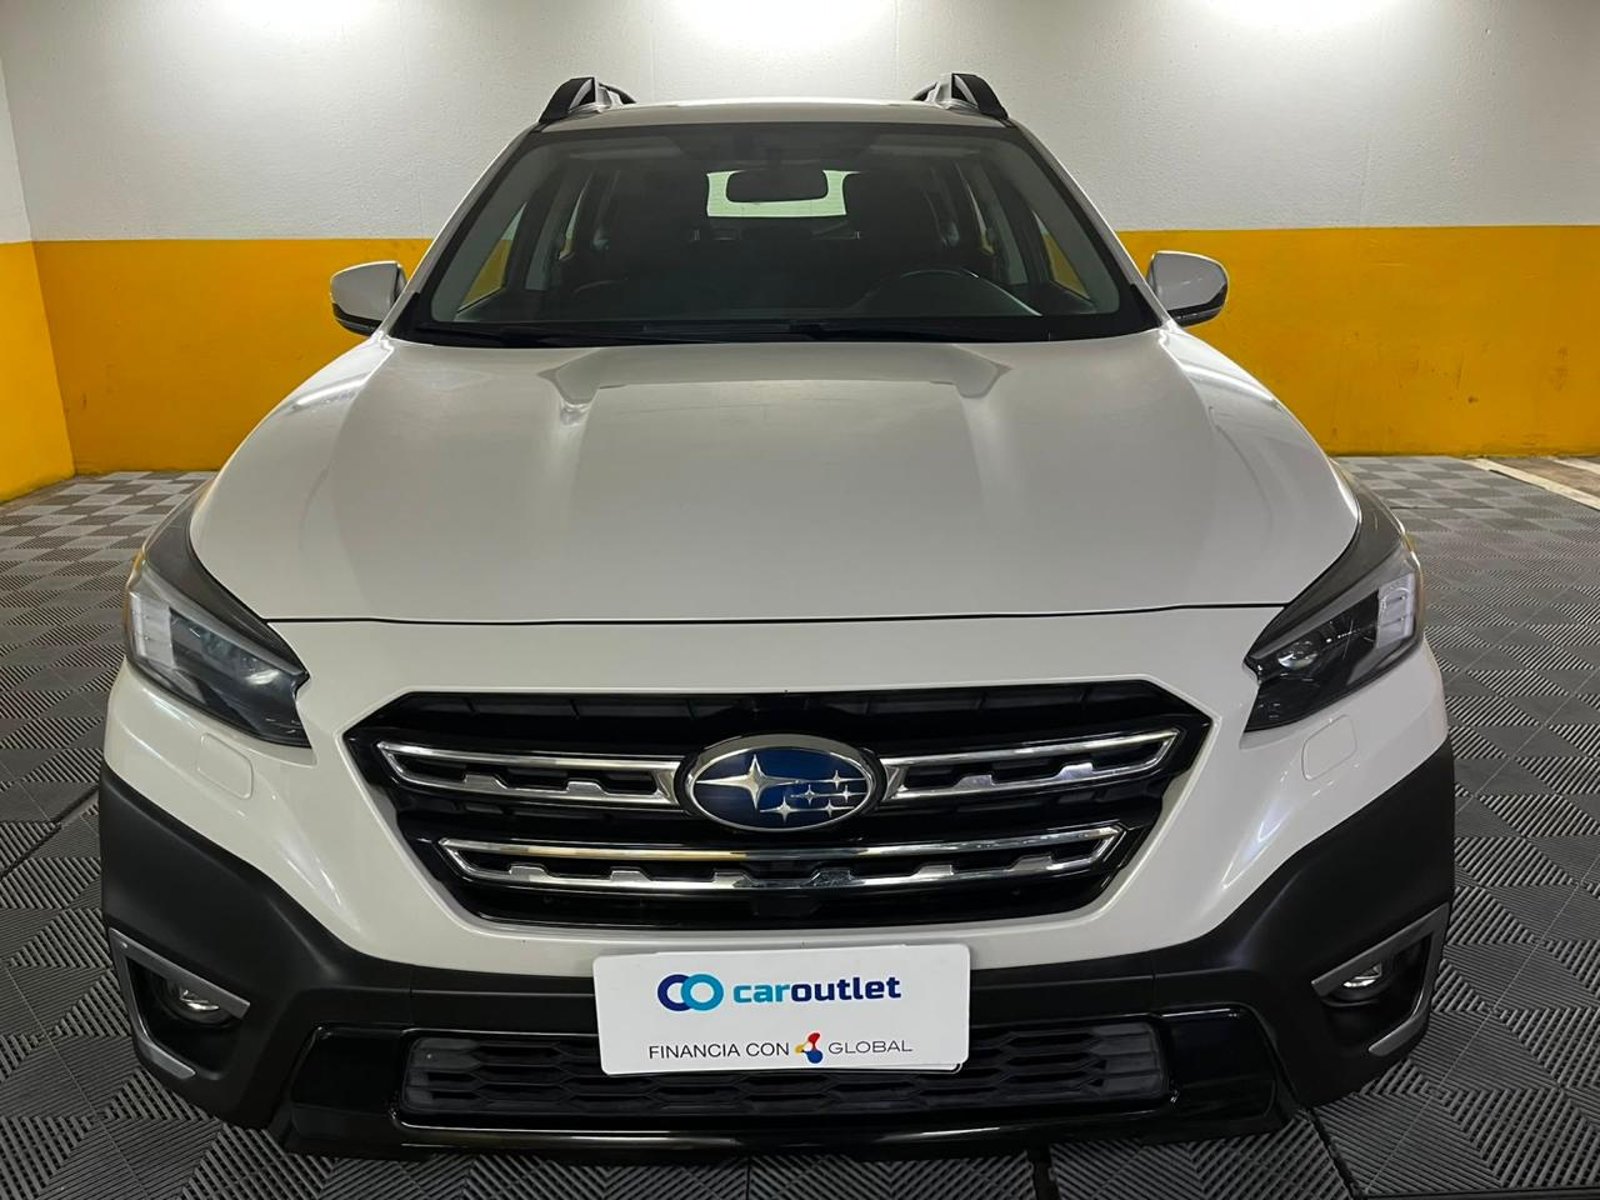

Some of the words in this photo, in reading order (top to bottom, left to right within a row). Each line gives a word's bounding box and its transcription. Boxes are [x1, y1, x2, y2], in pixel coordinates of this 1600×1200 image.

[733, 976, 901, 1003] caroutlet
[648, 1043, 740, 1060] FINANCIA
[745, 1042, 790, 1057] CON
[828, 1039, 913, 1055] GLOBAL
